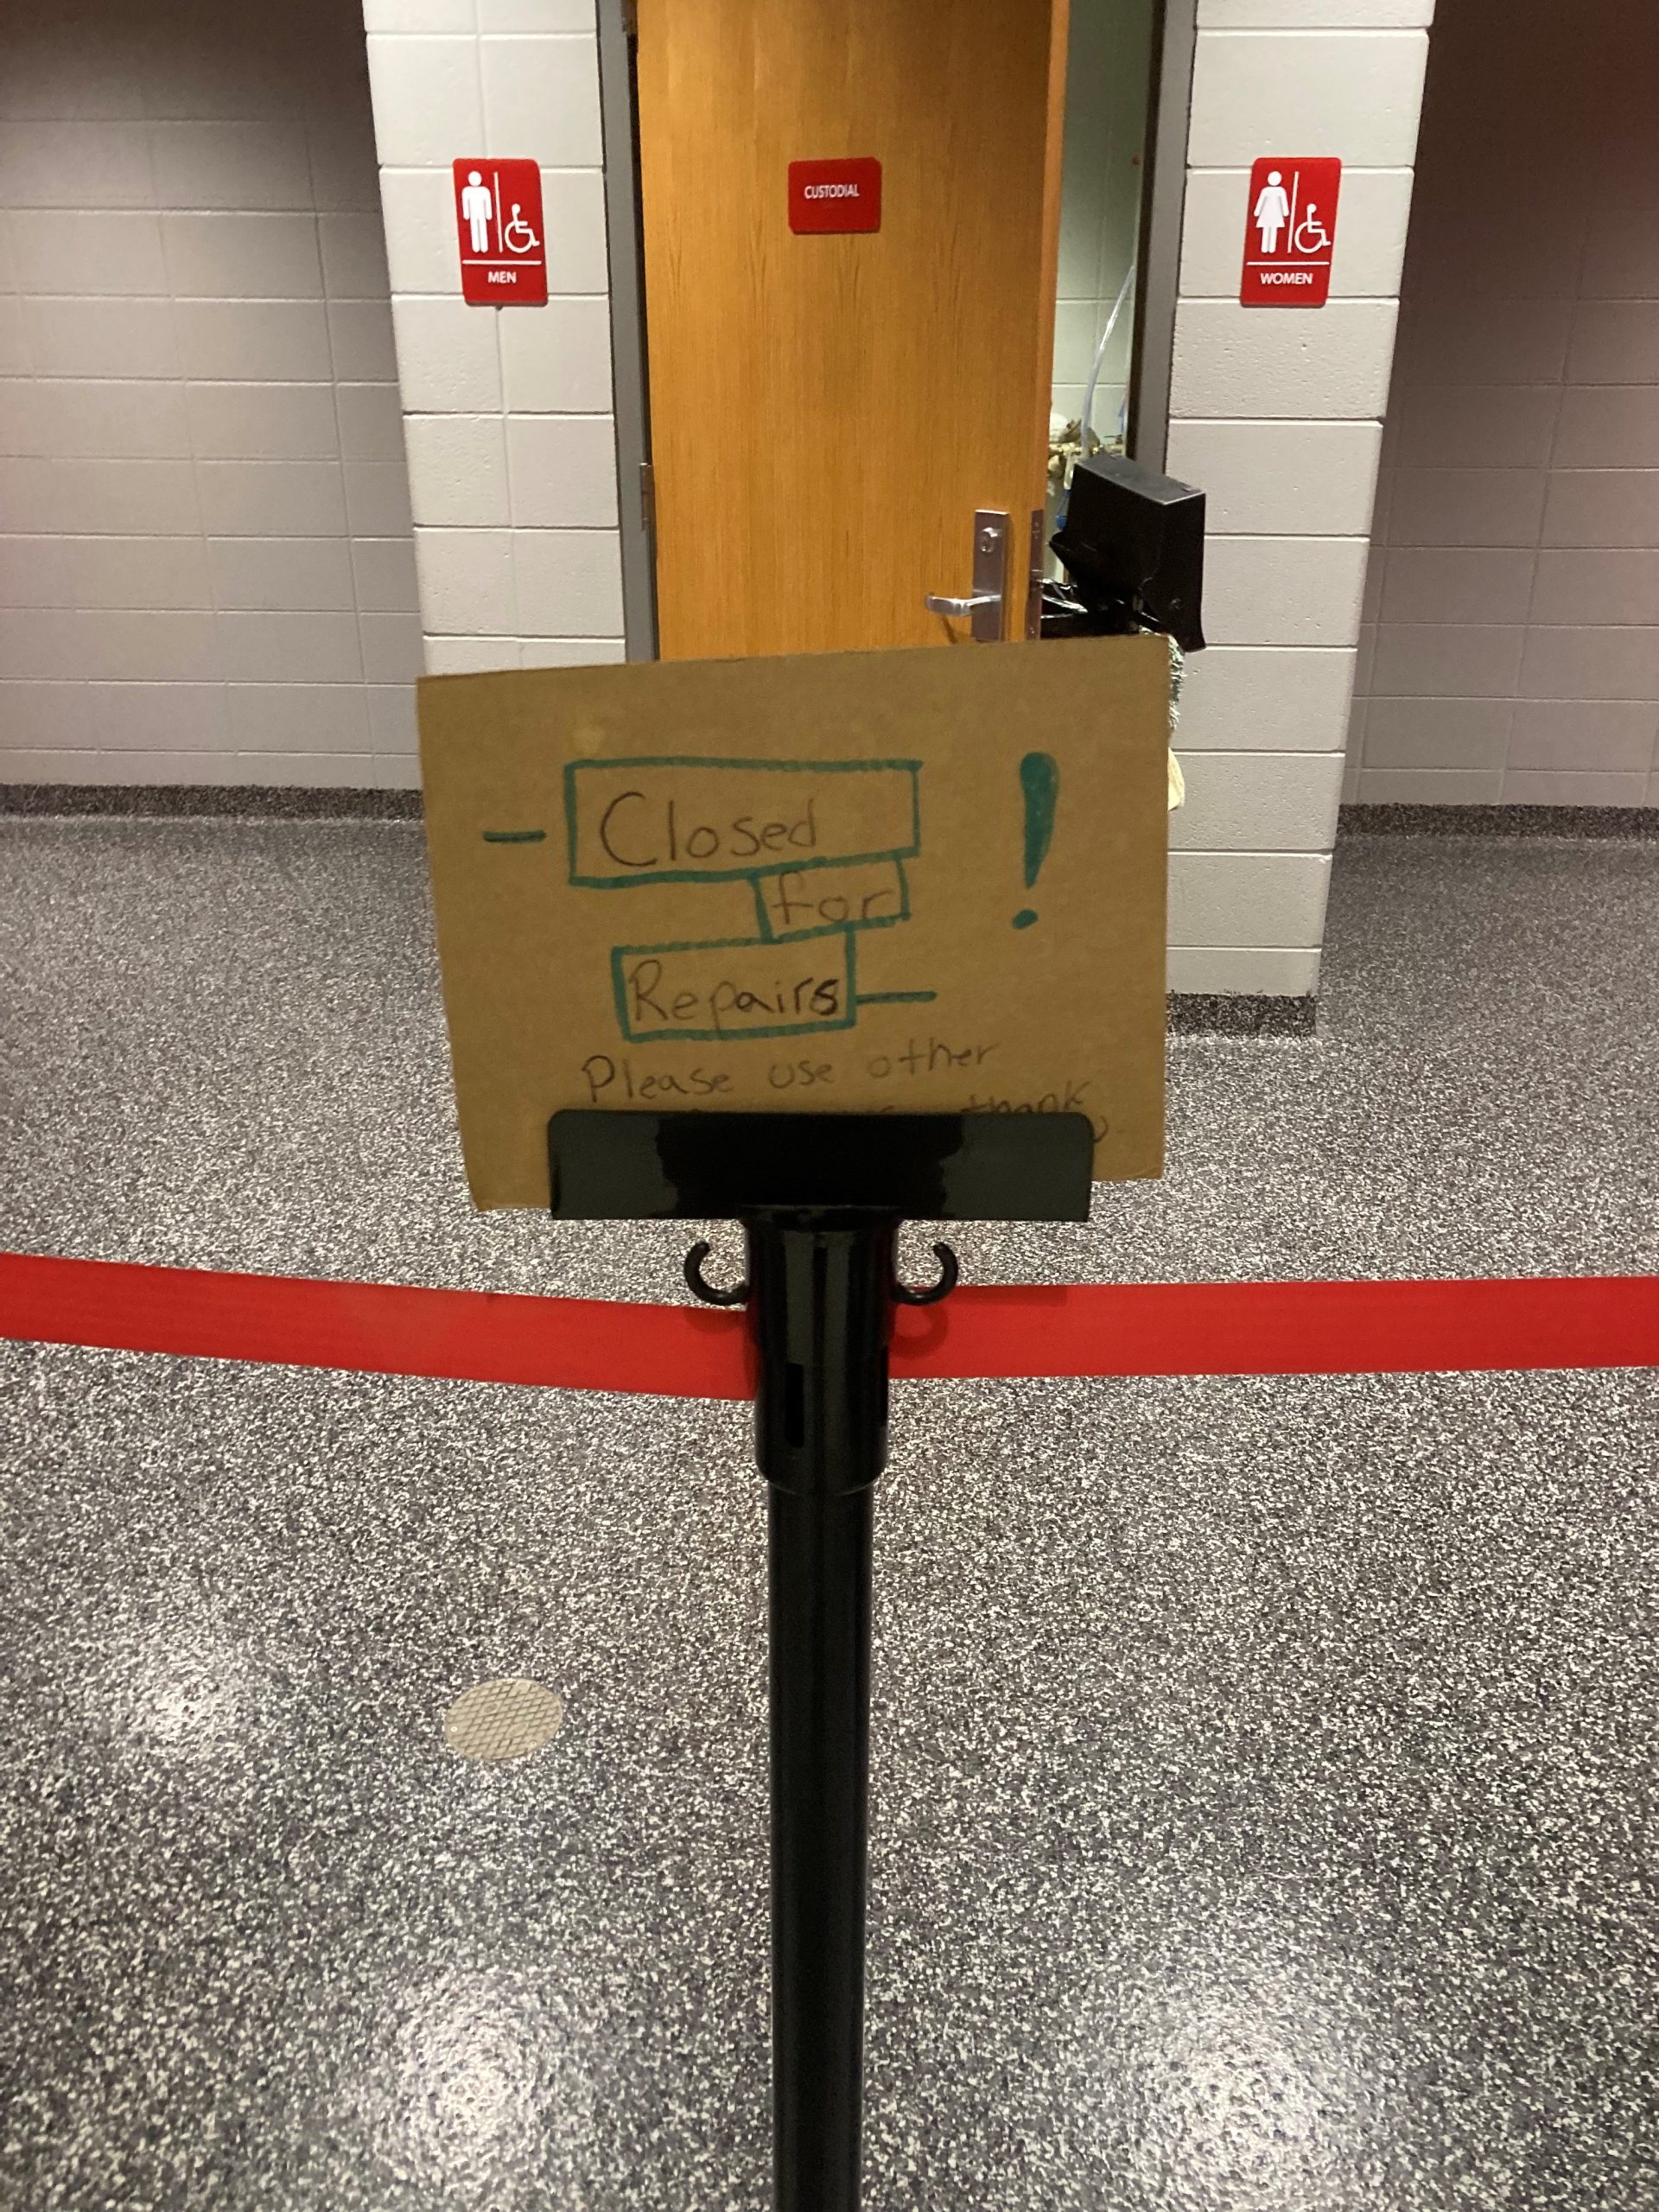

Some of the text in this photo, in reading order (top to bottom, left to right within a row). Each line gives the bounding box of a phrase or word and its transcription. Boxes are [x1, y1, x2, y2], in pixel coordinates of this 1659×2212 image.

[804, 183, 861, 200] CUSTODIAL
[487, 270, 518, 284] MEN
[1260, 272, 1313, 285] WOMEN
[600, 791, 817, 868] Closed
[773, 868, 894, 925] for
[629, 958, 840, 1035] Repairs
[582, 1054, 733, 1103] Please
[868, 1037, 1001, 1078] other
